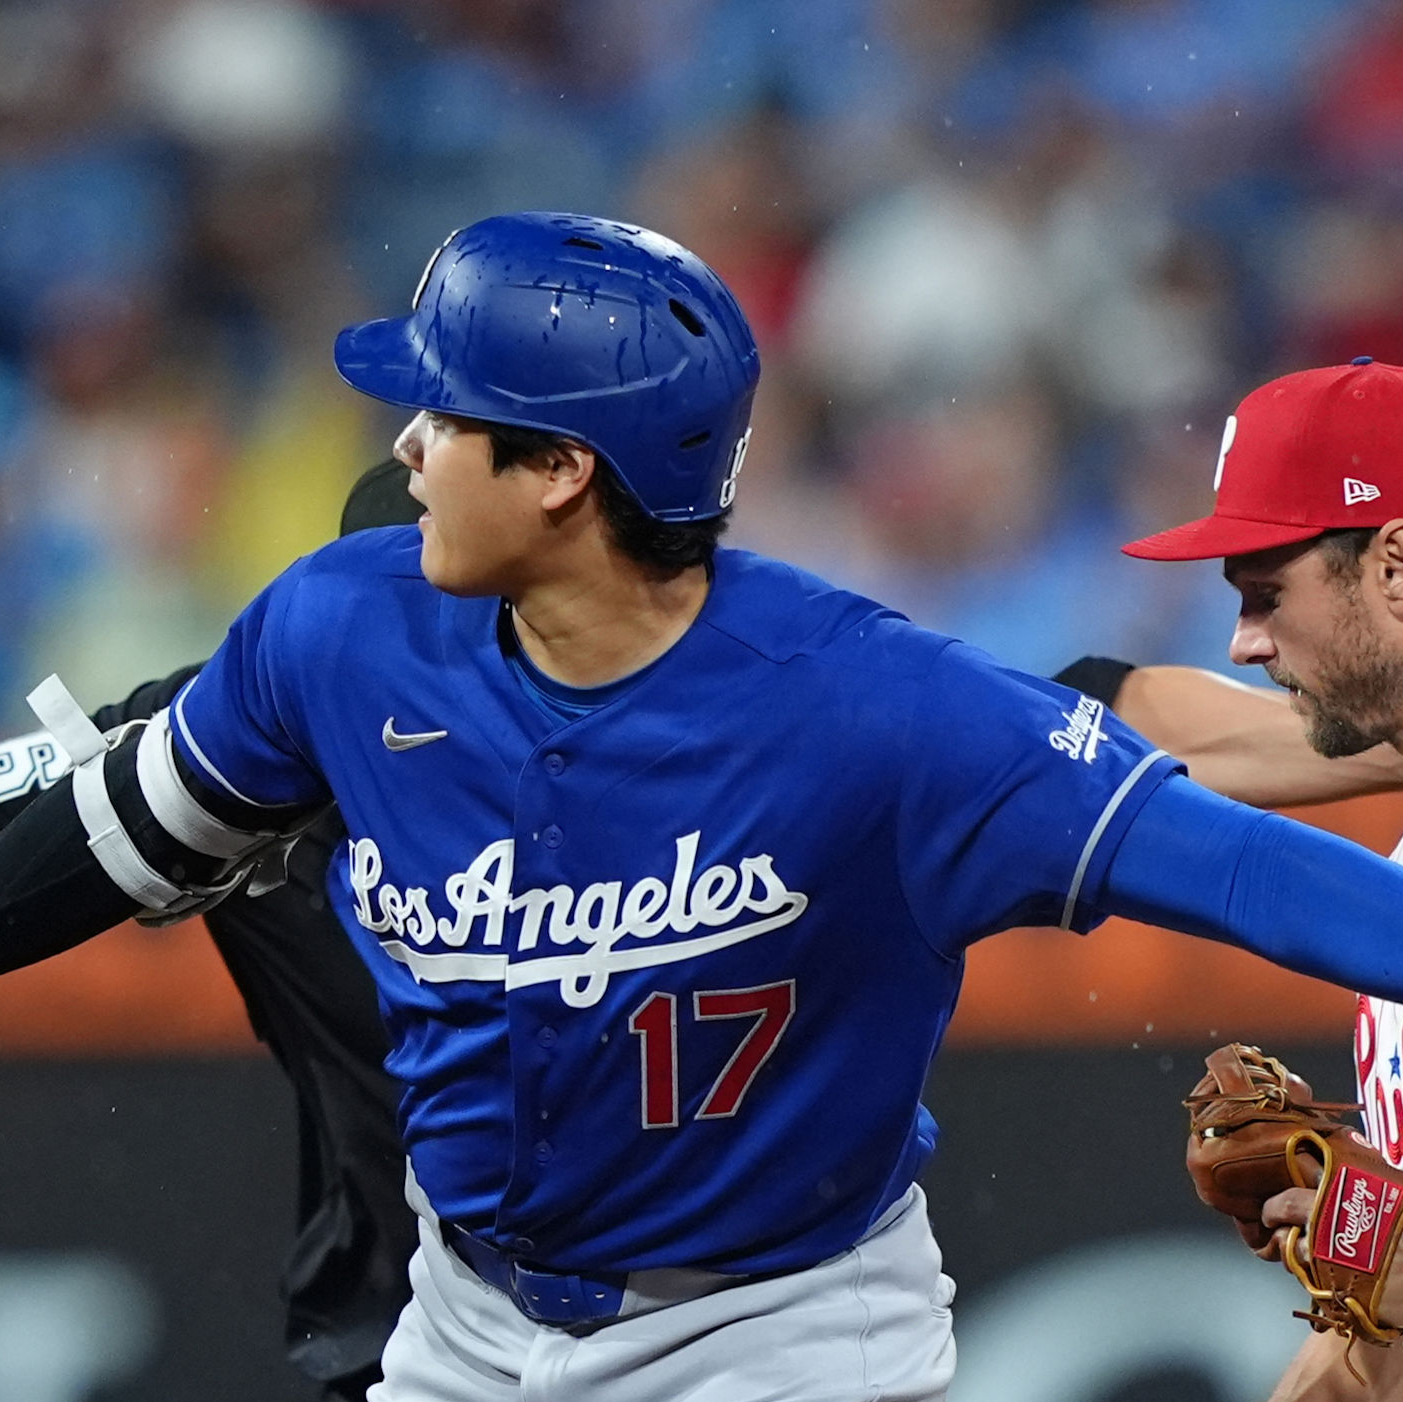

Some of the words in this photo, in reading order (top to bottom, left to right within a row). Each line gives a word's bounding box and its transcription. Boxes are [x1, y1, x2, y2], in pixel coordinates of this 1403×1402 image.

[1049, 694, 1107, 762] Dodgers
[348, 837, 436, 946] Los
[437, 830, 800, 1009] Angeles
[628, 978, 797, 1130] 17
[1335, 1178, 1376, 1257] Rawlings
